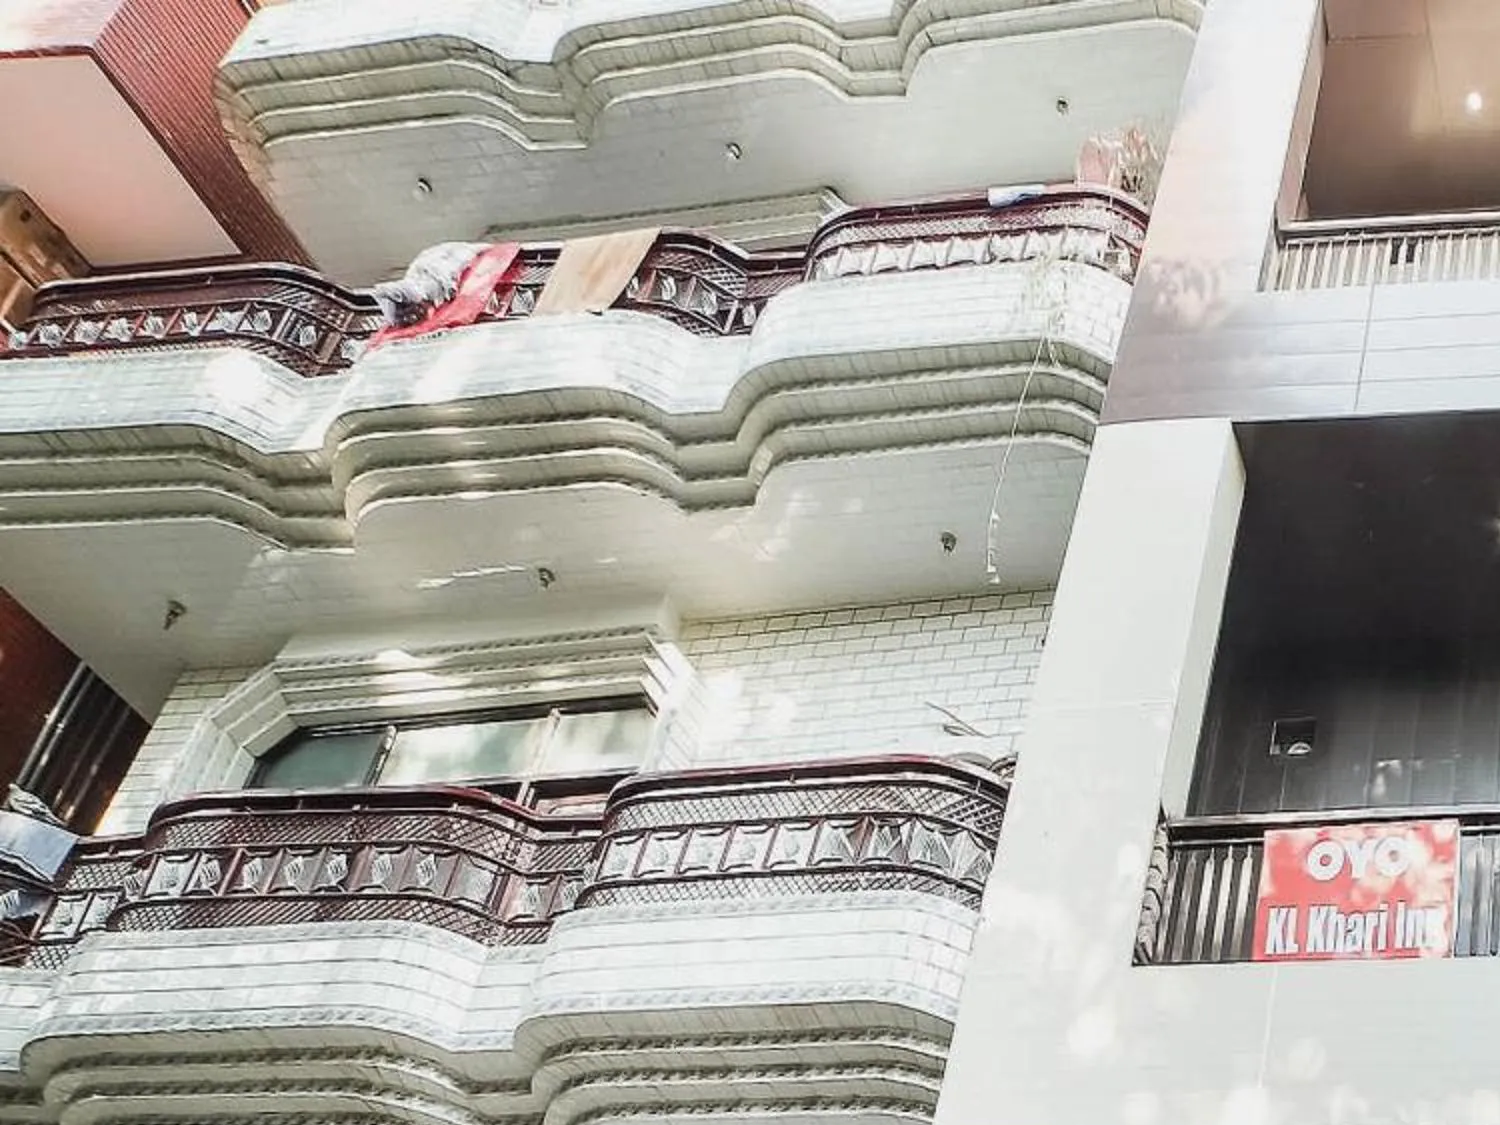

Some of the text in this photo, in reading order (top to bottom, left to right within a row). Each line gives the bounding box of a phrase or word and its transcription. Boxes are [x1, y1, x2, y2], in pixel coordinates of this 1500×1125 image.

[1307, 836, 1410, 881] OYO
[1265, 905, 1298, 955] KL
[1307, 902, 1388, 953] Khari
